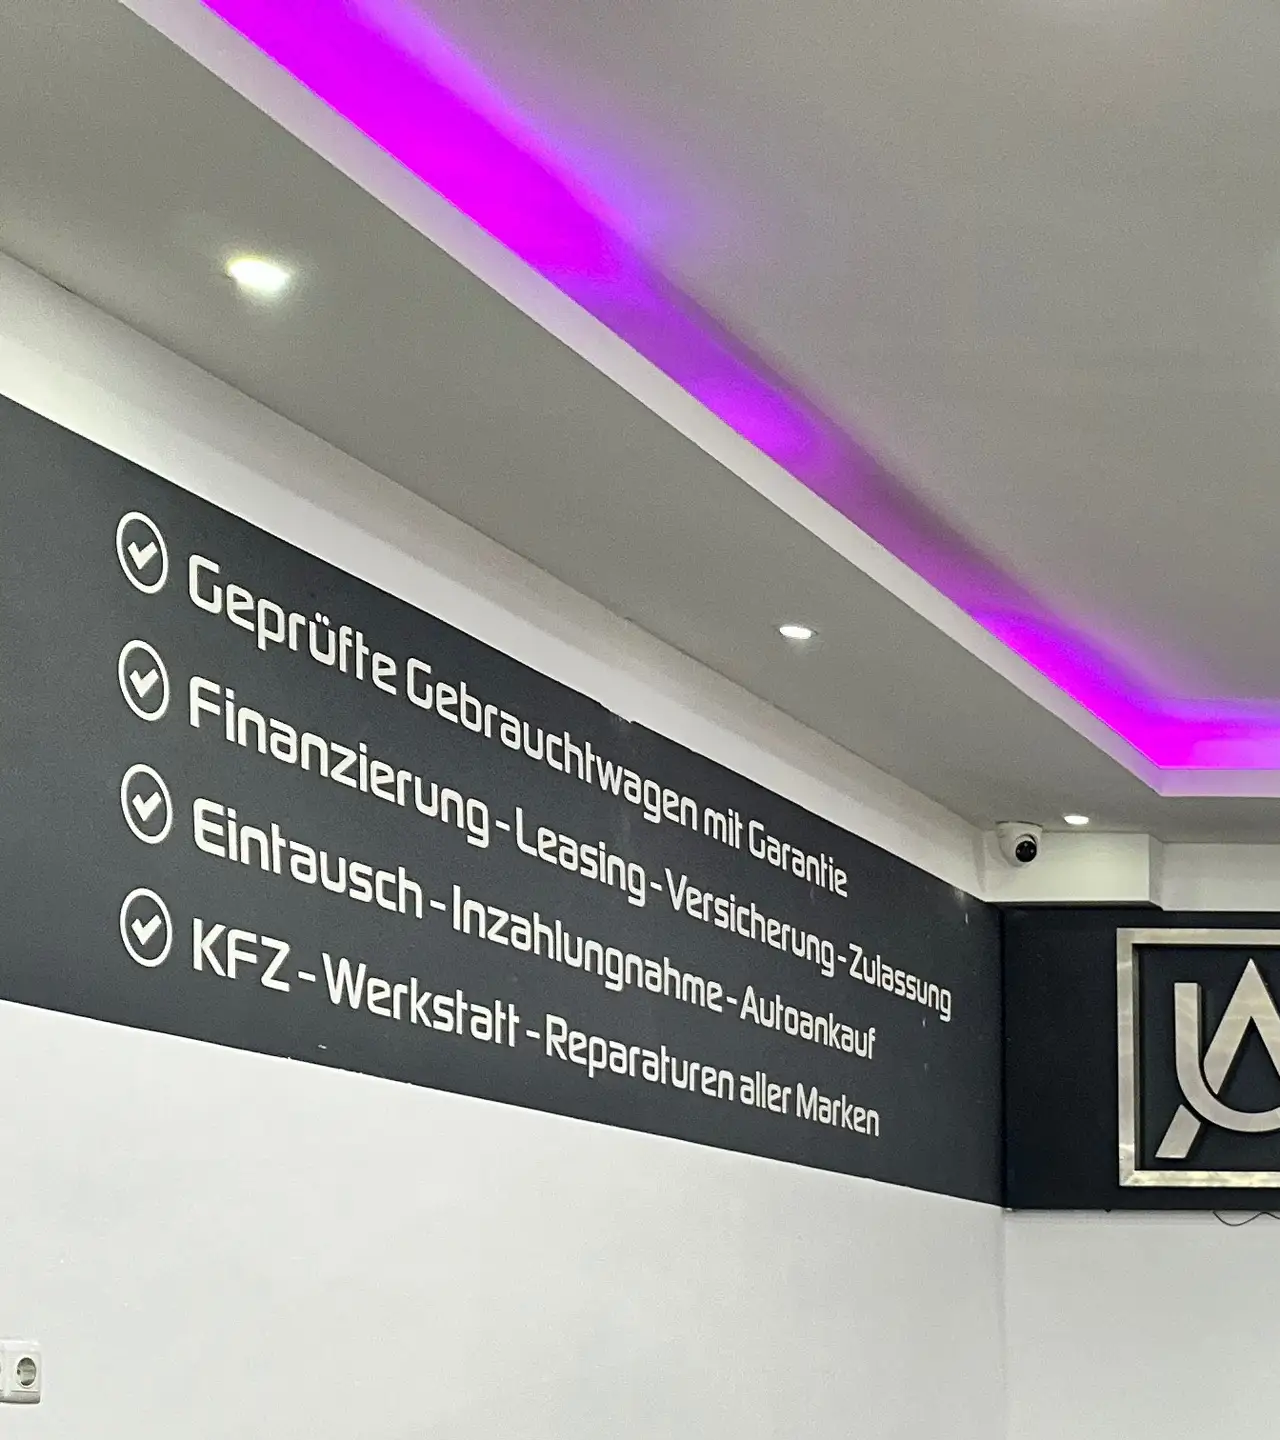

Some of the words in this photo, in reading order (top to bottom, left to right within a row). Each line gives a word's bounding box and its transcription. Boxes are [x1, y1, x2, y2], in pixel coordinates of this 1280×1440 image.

[189, 555, 396, 695] Geprüfte
[407, 658, 697, 830] Gebrauchtwagen
[704, 808, 742, 849] mit
[749, 820, 847, 897] Garantie
[190, 676, 489, 848] Finanzierung
[516, 807, 645, 907] Leasing
[665, 868, 834, 977] Versicherung
[849, 943, 951, 1022] Zulassung
[193, 798, 422, 919] Eintausch
[453, 885, 722, 1012] Inzahlungnahme
[740, 986, 875, 1059] Autoankauf
[193, 918, 290, 992] KFZ
[322, 953, 519, 1047] Werkstatt
[546, 1014, 734, 1101] Reparaturen
[740, 1071, 791, 1113] aller
[797, 1083, 879, 1136] Marken
